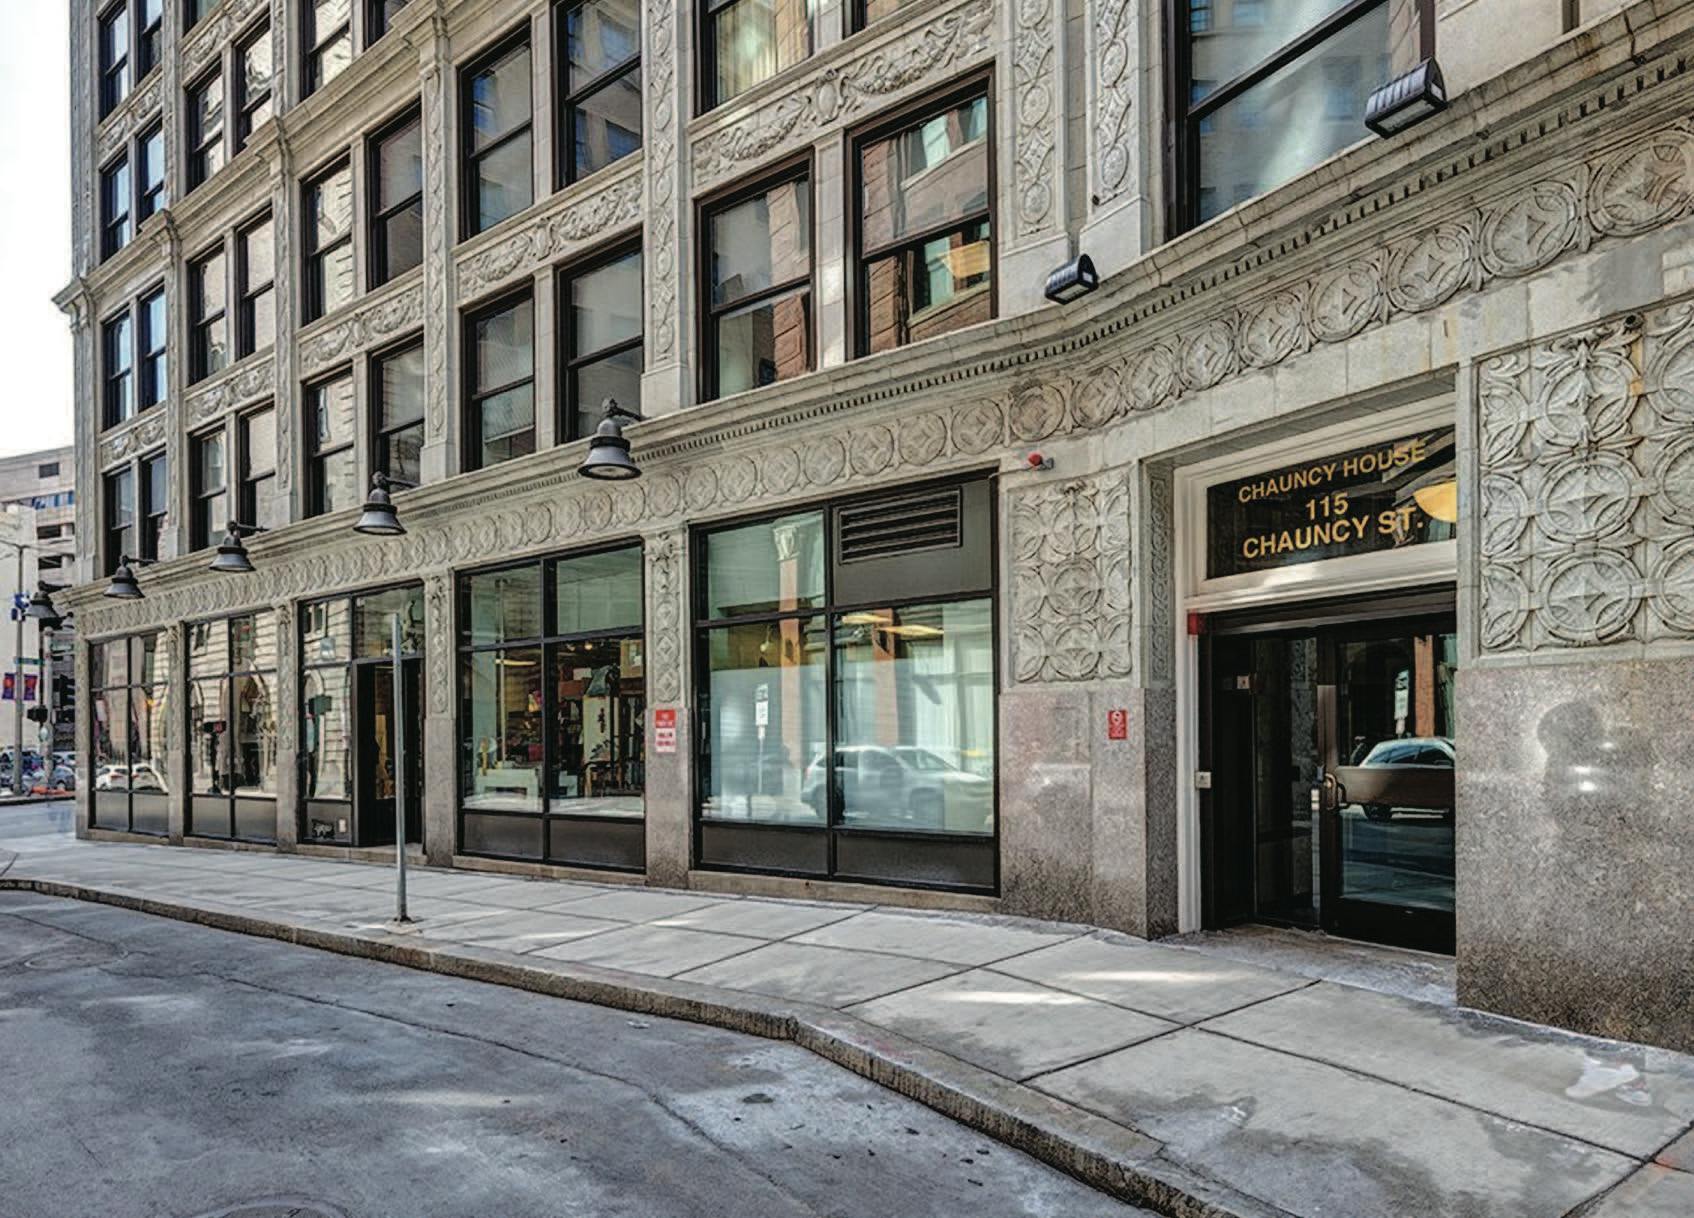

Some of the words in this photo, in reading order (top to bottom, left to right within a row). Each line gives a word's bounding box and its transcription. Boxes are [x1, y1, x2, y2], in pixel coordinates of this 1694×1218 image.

[1238, 463, 1338, 503] CHAUNCY
[1343, 438, 1427, 478] HOUSE
[1243, 514, 1370, 559] CHAUNCY
[1378, 505, 1424, 536] ST.
[1306, 491, 1349, 520] 115
